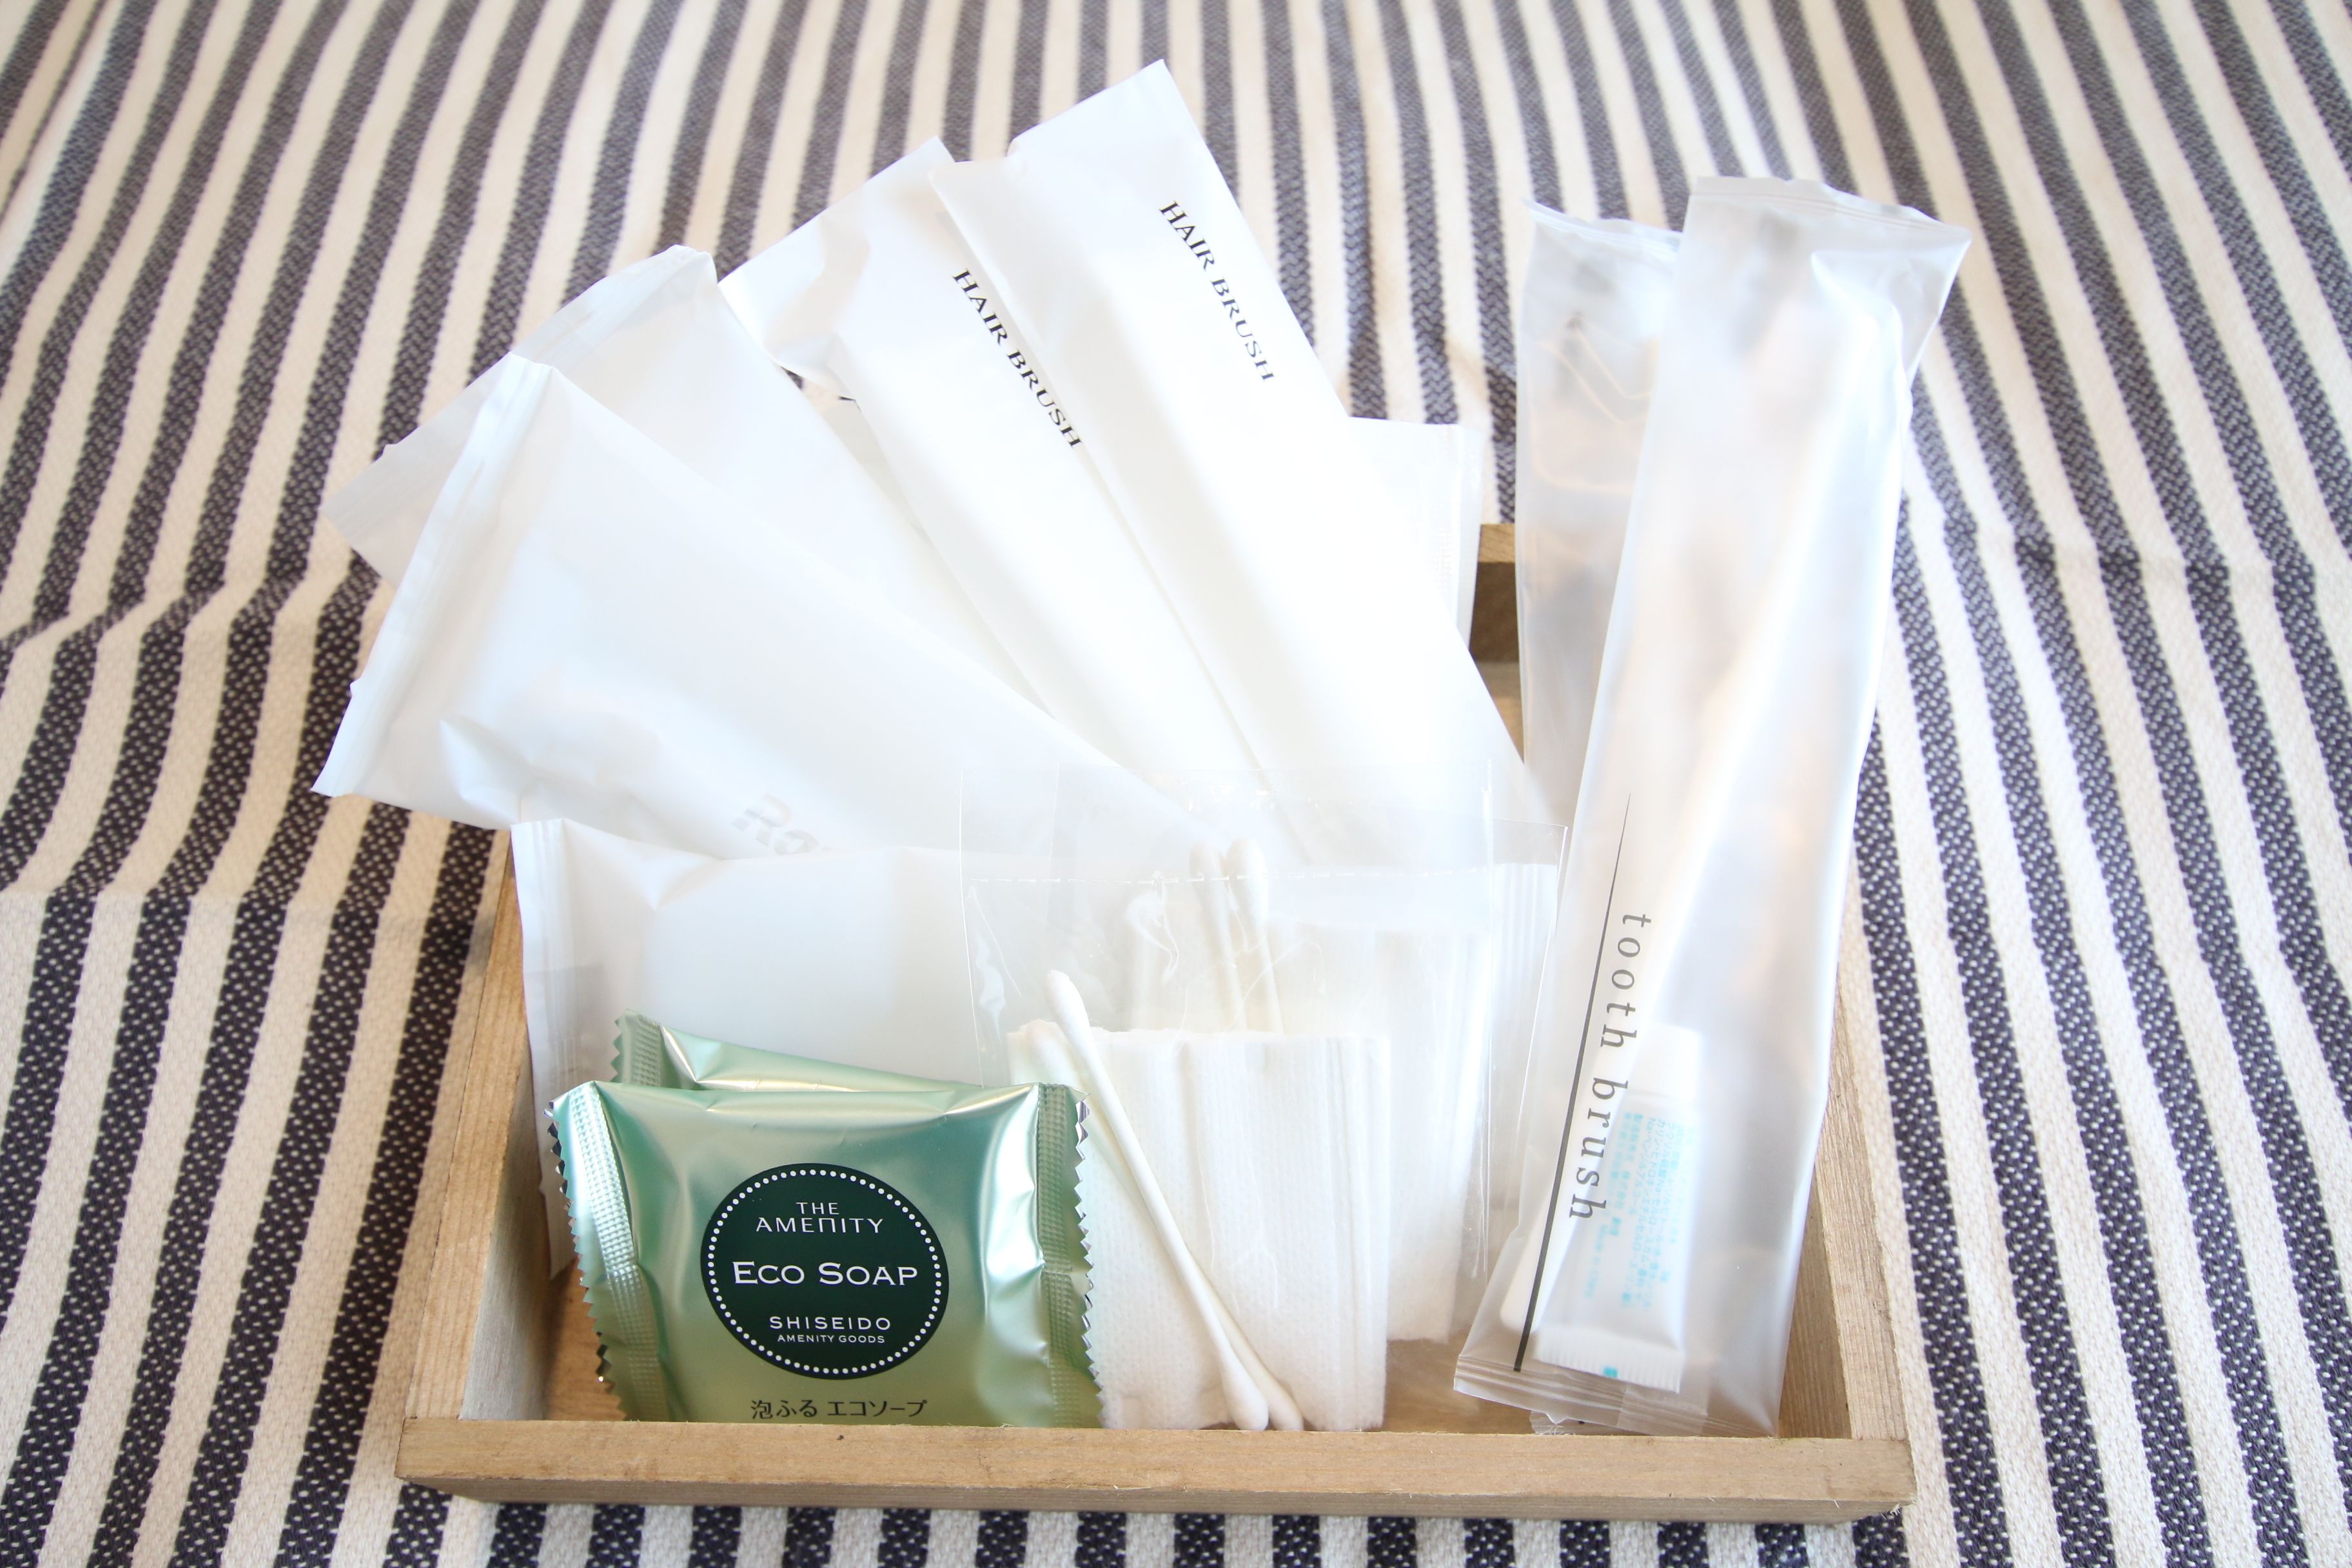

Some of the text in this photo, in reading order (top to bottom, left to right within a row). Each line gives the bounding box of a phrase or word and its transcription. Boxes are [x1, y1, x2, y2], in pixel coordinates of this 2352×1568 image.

[1159, 201, 1275, 380] HAIR BRUSH
[952, 268, 1083, 449] HAIR BRUSH
[1600, 914, 1651, 1047] tooth
[1569, 1077, 1629, 1217] brush
[796, 1202, 839, 1215] THE
[756, 1217, 883, 1233] AMENITY
[732, 1261, 918, 1286] ECO SOAP
[769, 1316, 891, 1331] SHISEIDO
[777, 1335, 885, 1344] AMENITY GOODS
[750, 1399, 928, 1420] 泡ふる エコソープ
